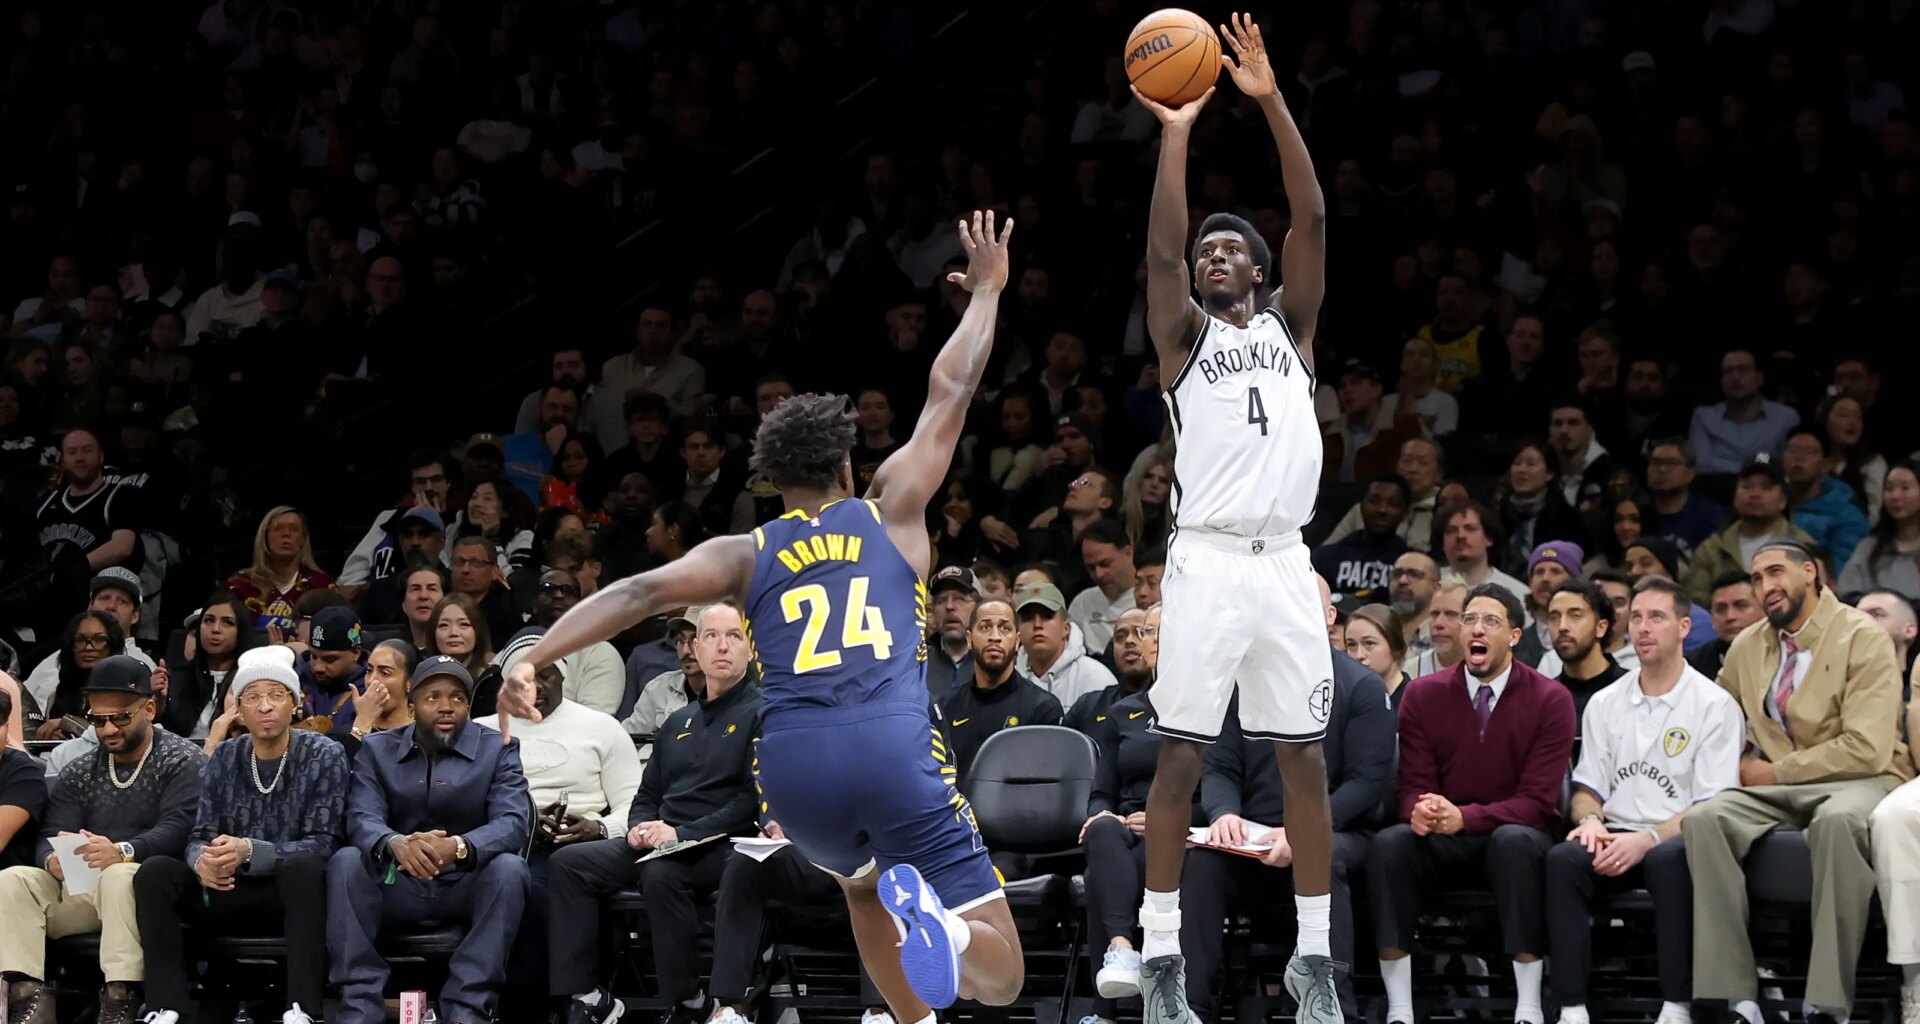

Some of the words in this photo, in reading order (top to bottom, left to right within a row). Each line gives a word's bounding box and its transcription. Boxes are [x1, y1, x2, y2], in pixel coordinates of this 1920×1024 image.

[1198, 341, 1293, 386] BROOKLYN
[1247, 386, 1269, 437] 4
[776, 533, 863, 574] BROWN
[779, 576, 894, 675] 24
